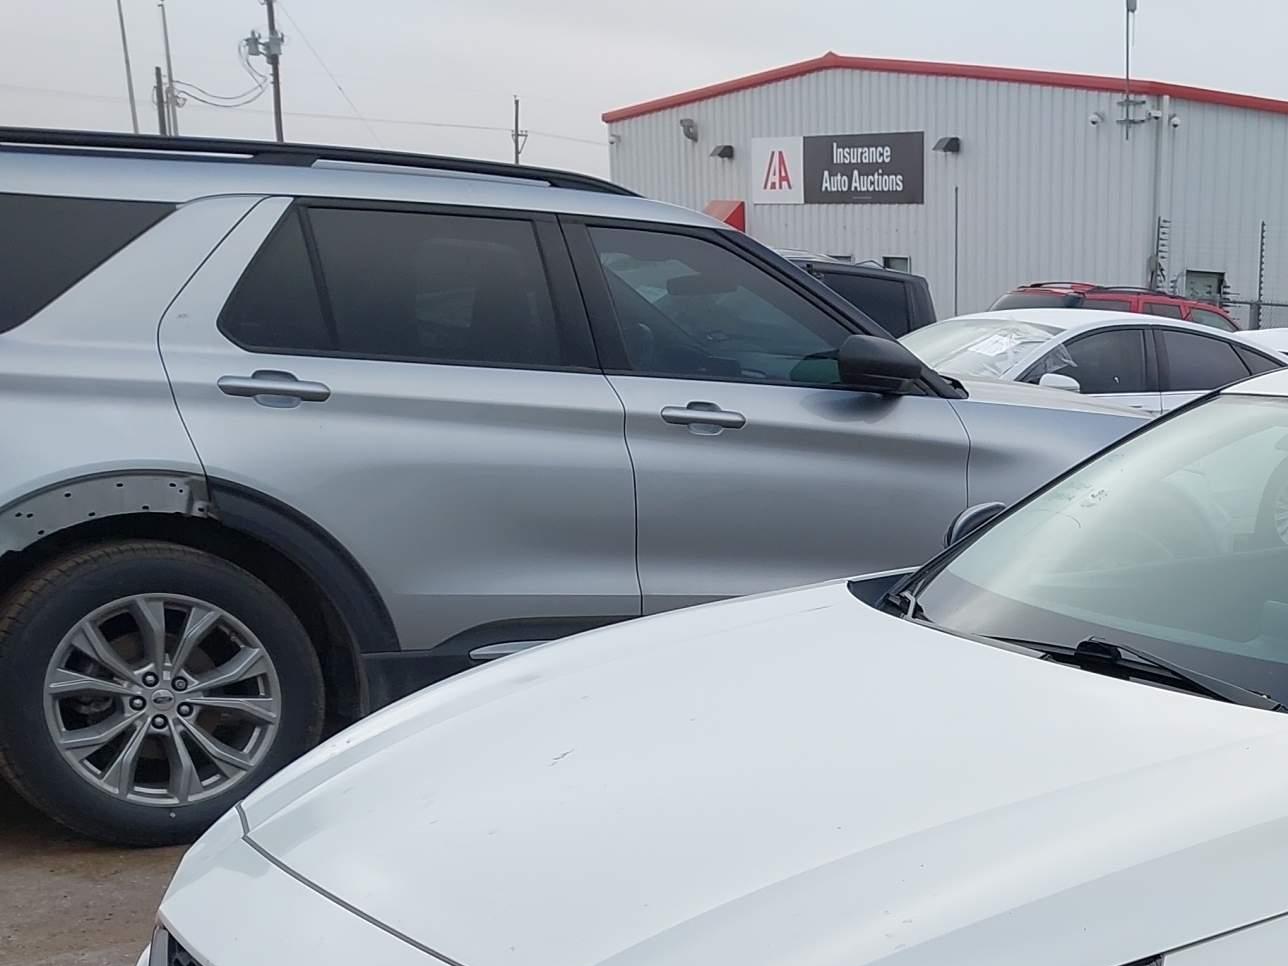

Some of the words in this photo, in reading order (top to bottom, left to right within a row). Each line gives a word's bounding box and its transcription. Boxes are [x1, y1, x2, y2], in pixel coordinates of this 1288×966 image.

[833, 142, 891, 164] Insurance
[822, 170, 849, 192] Auto
[851, 169, 904, 192] Auctions
